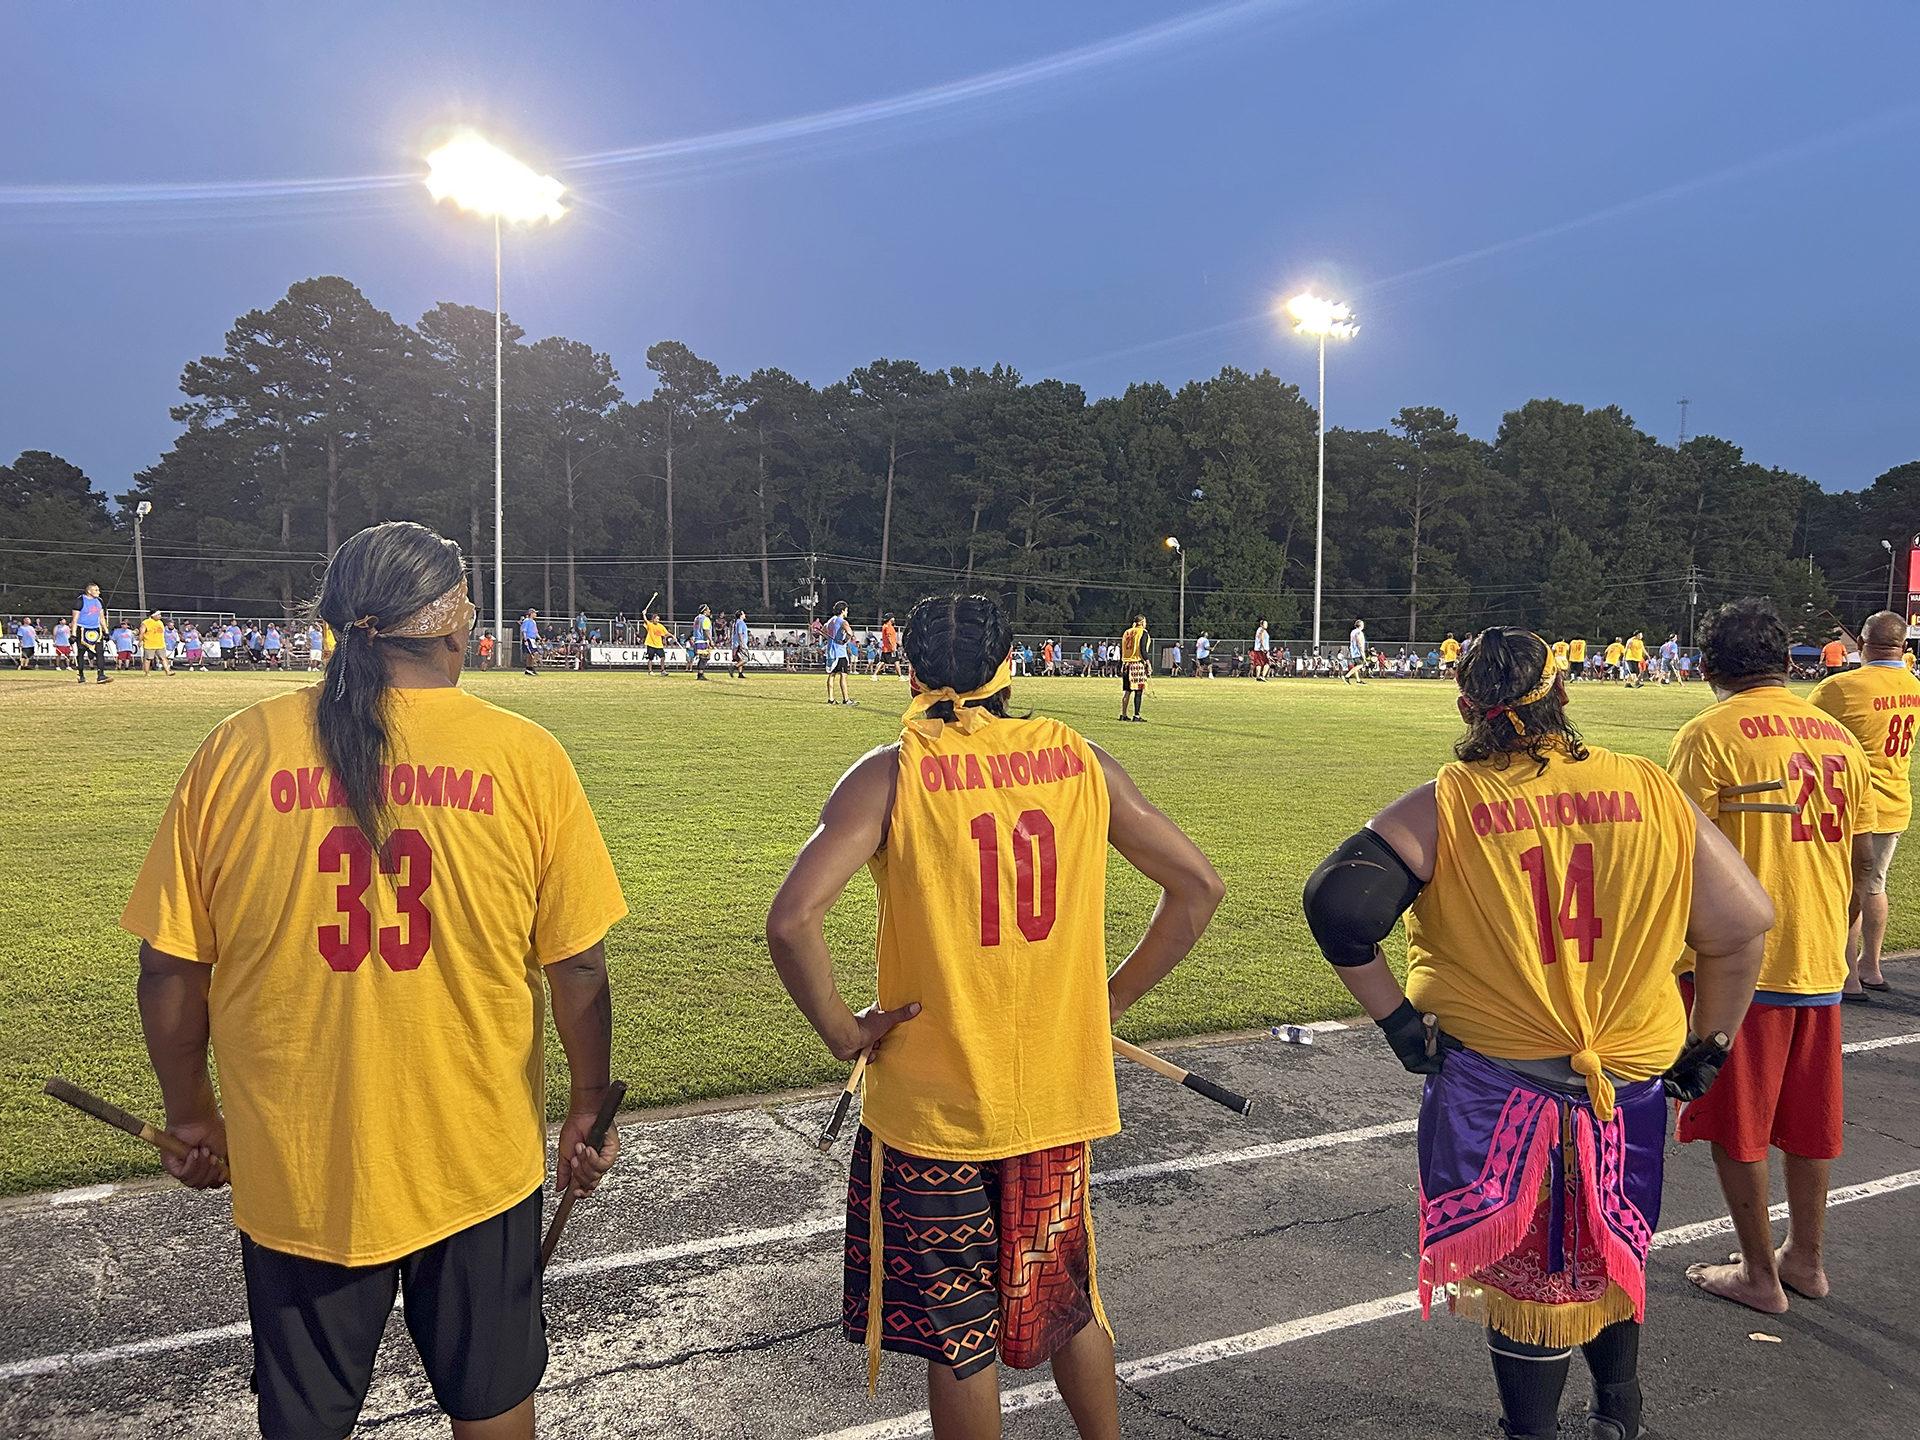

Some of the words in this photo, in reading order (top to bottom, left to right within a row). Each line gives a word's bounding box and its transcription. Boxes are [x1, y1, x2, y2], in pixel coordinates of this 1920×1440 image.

[1739, 715, 1790, 740] OKA
[1873, 695, 1897, 711] OKA
[920, 754, 986, 793] OKA
[986, 744, 1085, 789] HOMMA
[1787, 752, 1846, 843] 25
[1471, 797, 1535, 837] OKA
[1535, 790, 1643, 828] HOMMA
[317, 825, 432, 972] 33
[970, 809, 1057, 947] 10
[1519, 842, 1602, 966] 14
